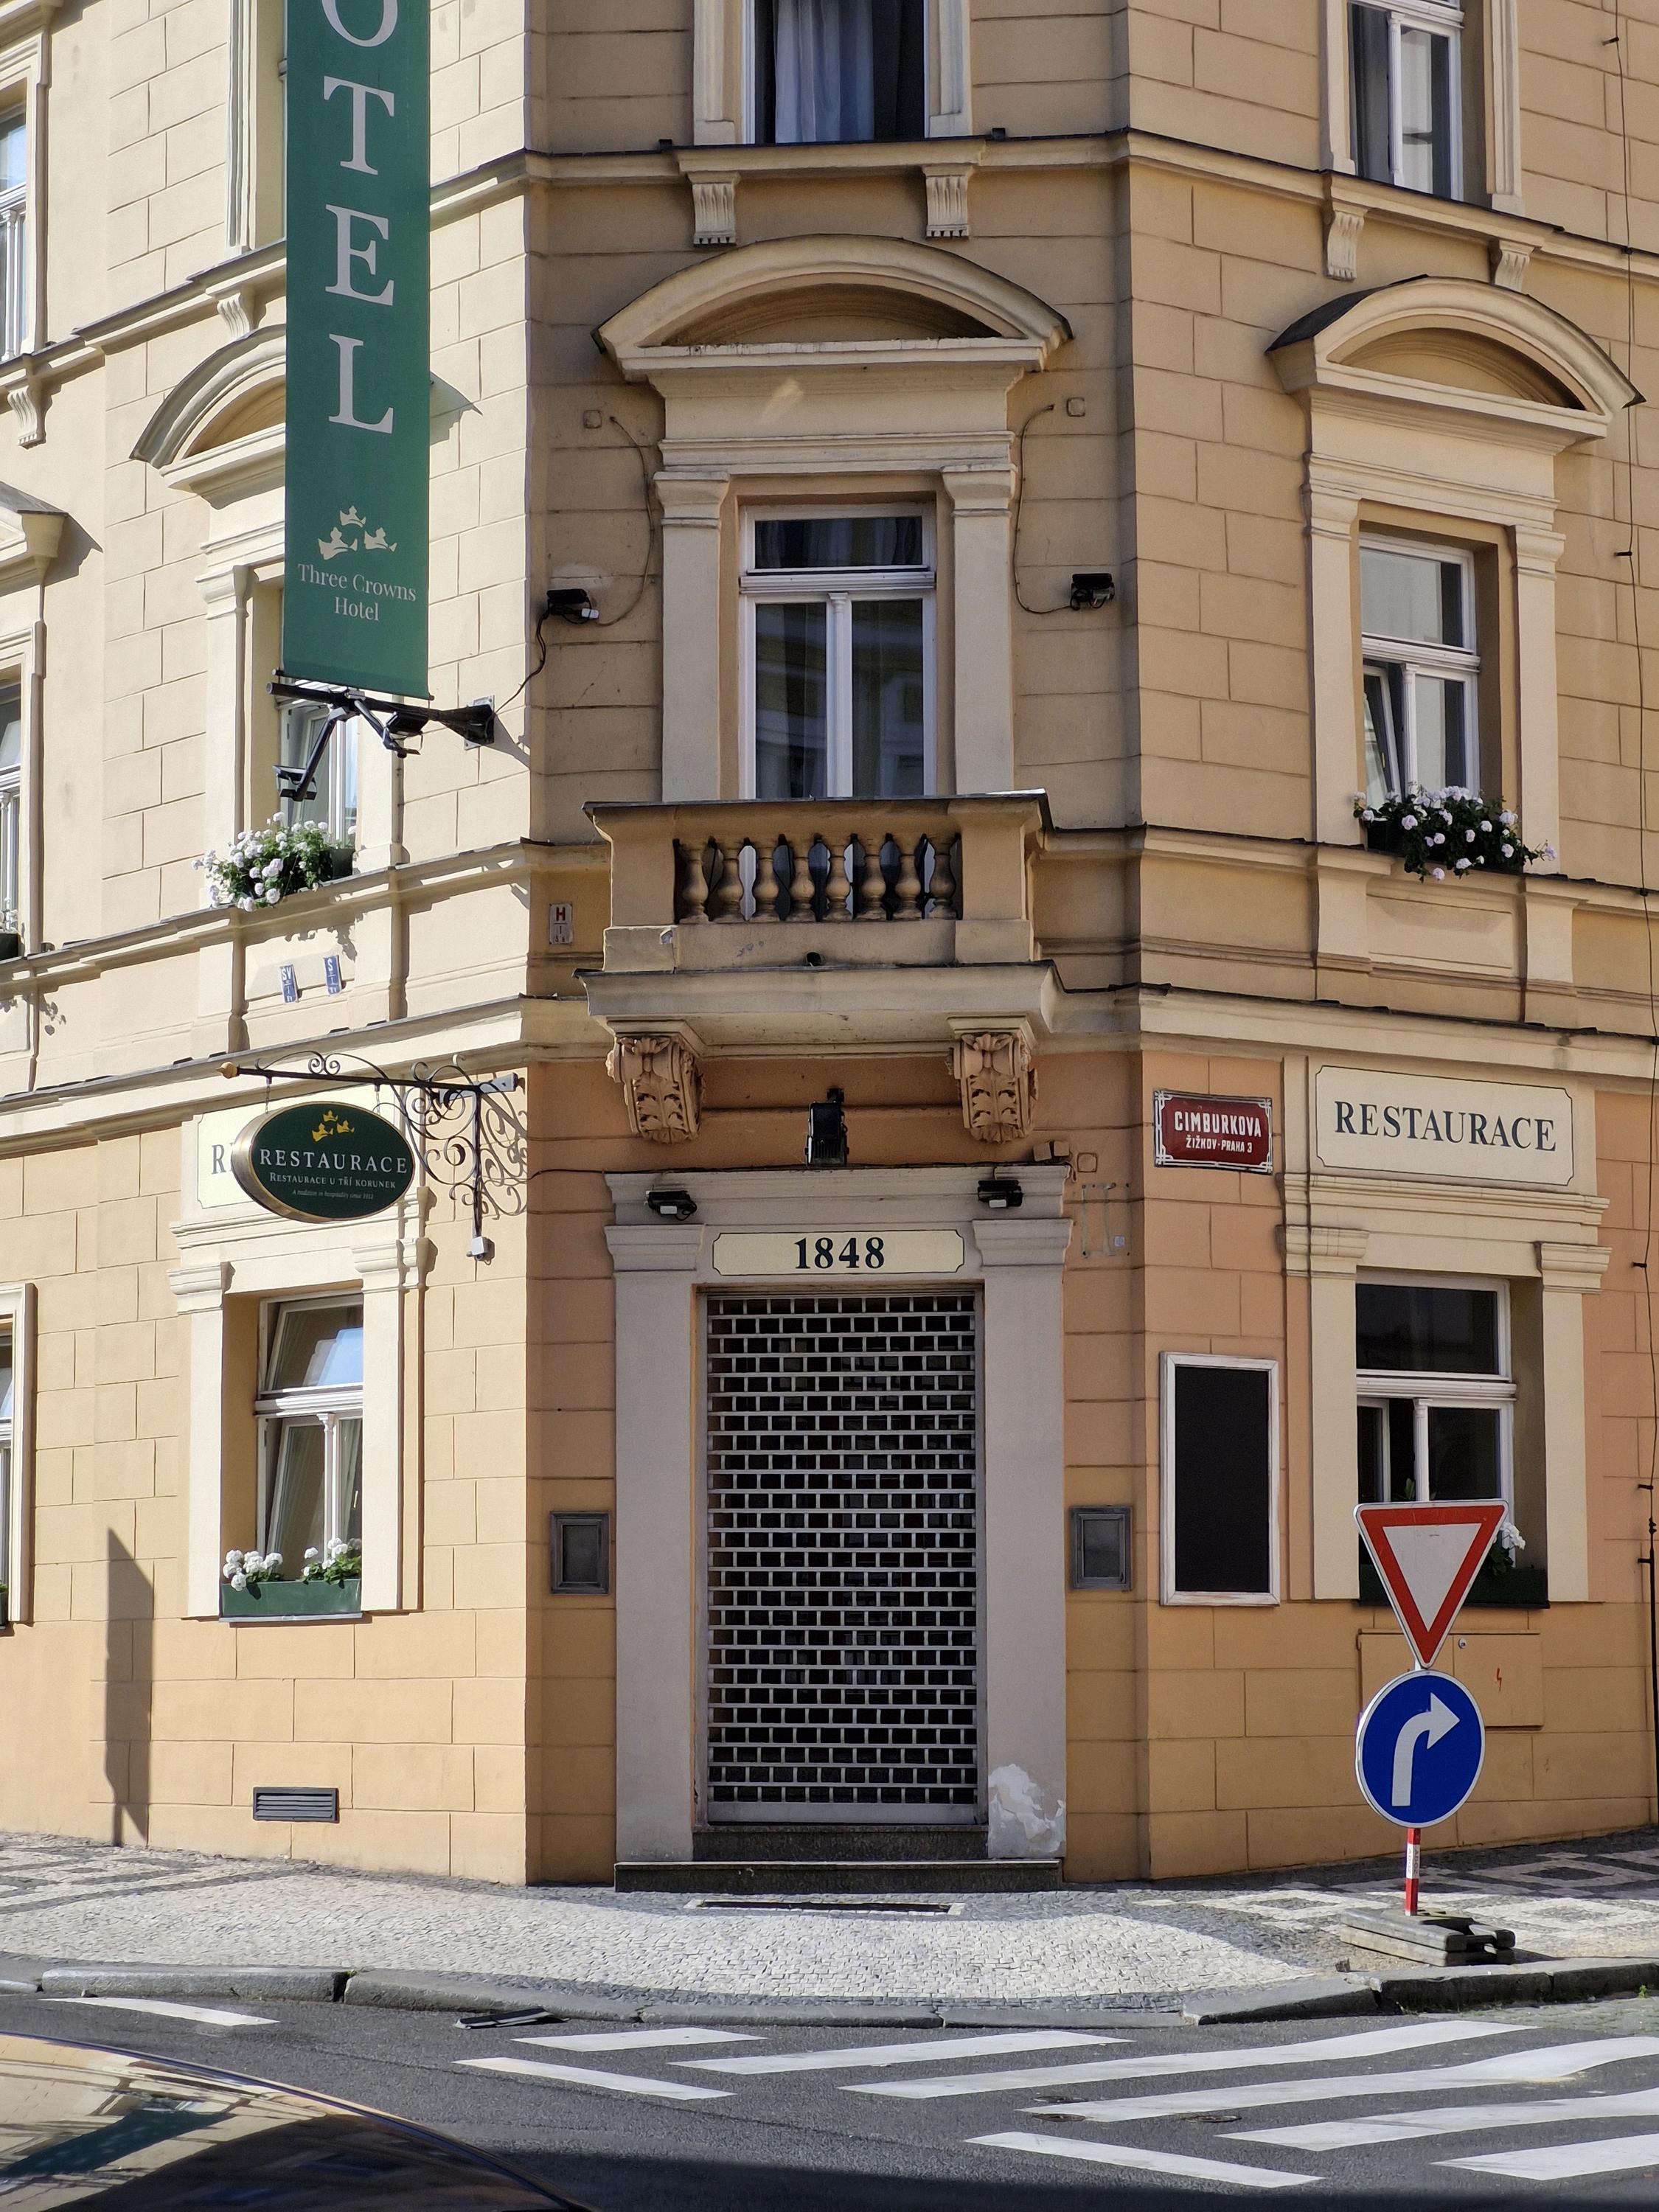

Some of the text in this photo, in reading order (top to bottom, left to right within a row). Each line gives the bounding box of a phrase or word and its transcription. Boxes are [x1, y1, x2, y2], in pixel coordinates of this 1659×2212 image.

[298, 563, 417, 602] Three Crowns
[335, 596, 380, 621] Hotel
[556, 907, 566, 921] H
[282, 967, 291, 980] SV
[1175, 1111, 1262, 1137] CIMBURKOVA
[1335, 1101, 1556, 1152] RESTAURACE
[1186, 1134, 1217, 1150] ŽIŽKOV
[1221, 1140, 1245, 1152] PRAHA
[1247, 1143, 1252, 1153] 3
[260, 1149, 408, 1174] RESTAURACE
[355, 1180, 396, 1189] KORUNEK
[794, 1237, 885, 1269] 1848
